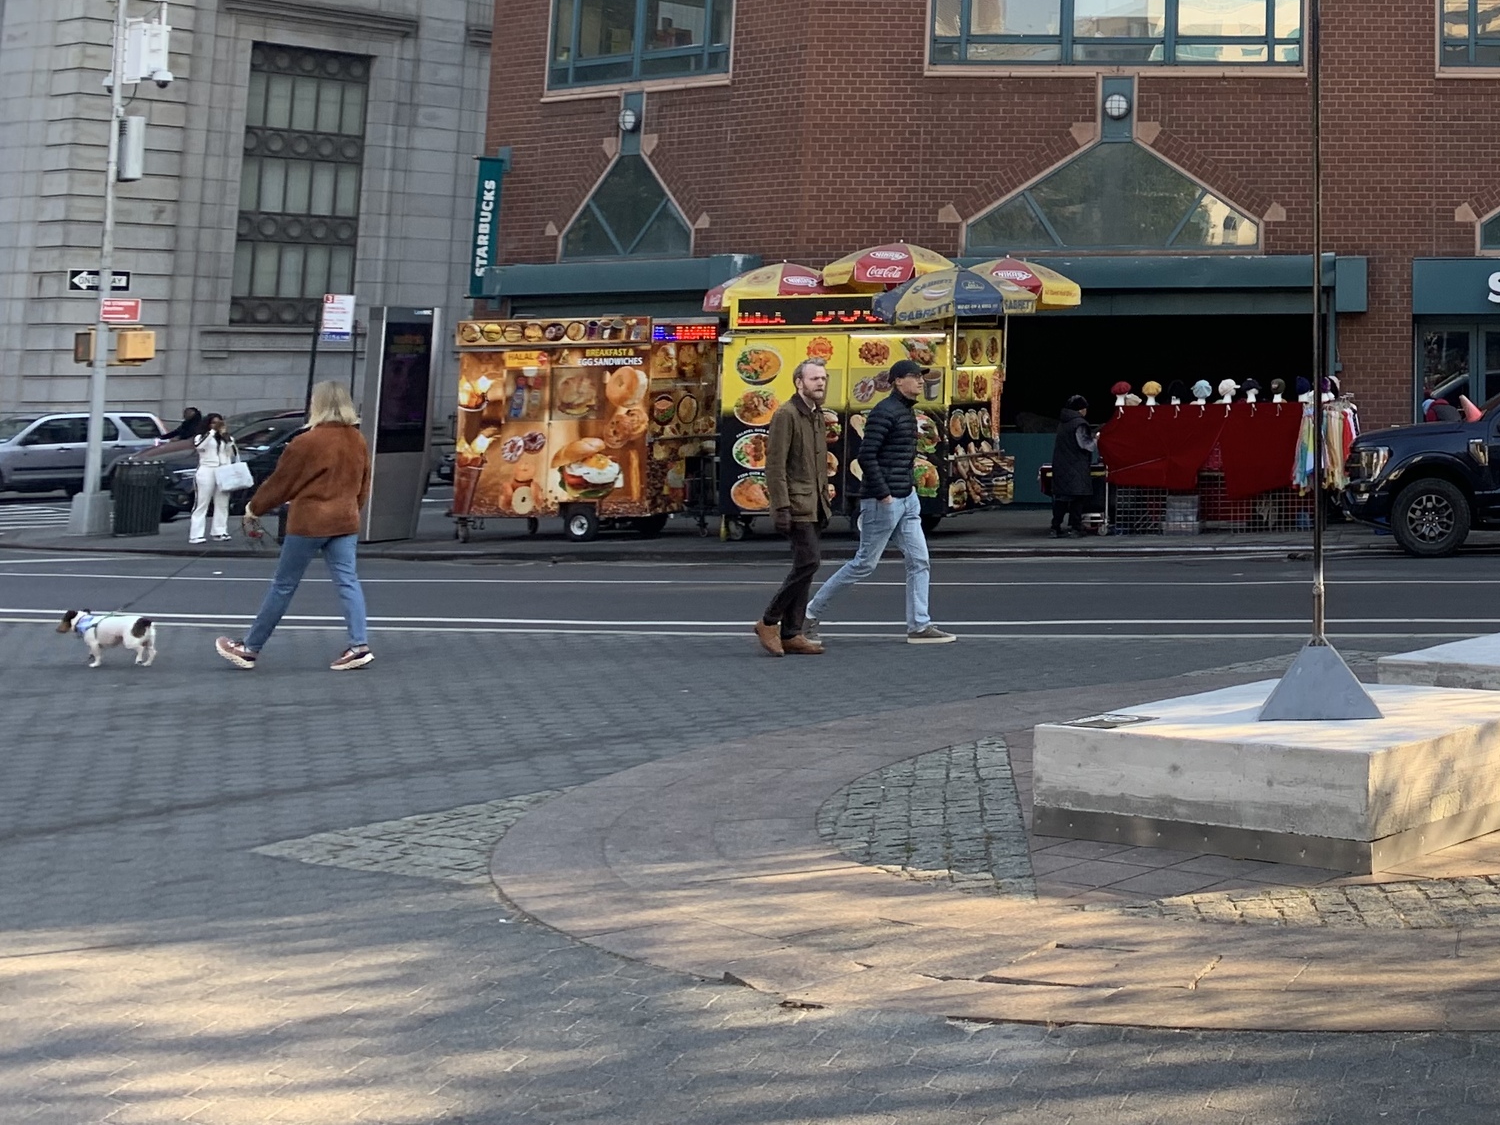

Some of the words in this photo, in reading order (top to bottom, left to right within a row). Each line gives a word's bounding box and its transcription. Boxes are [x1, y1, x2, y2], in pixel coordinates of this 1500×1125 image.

[474, 179, 497, 277] STARBUCKS
[79, 276, 98, 285] ONE
[897, 302, 952, 322] SABRETT
[585, 348, 627, 357] BREAKFAST
[577, 357, 593, 366] EGG
[594, 357, 643, 366] SANDWICHES
